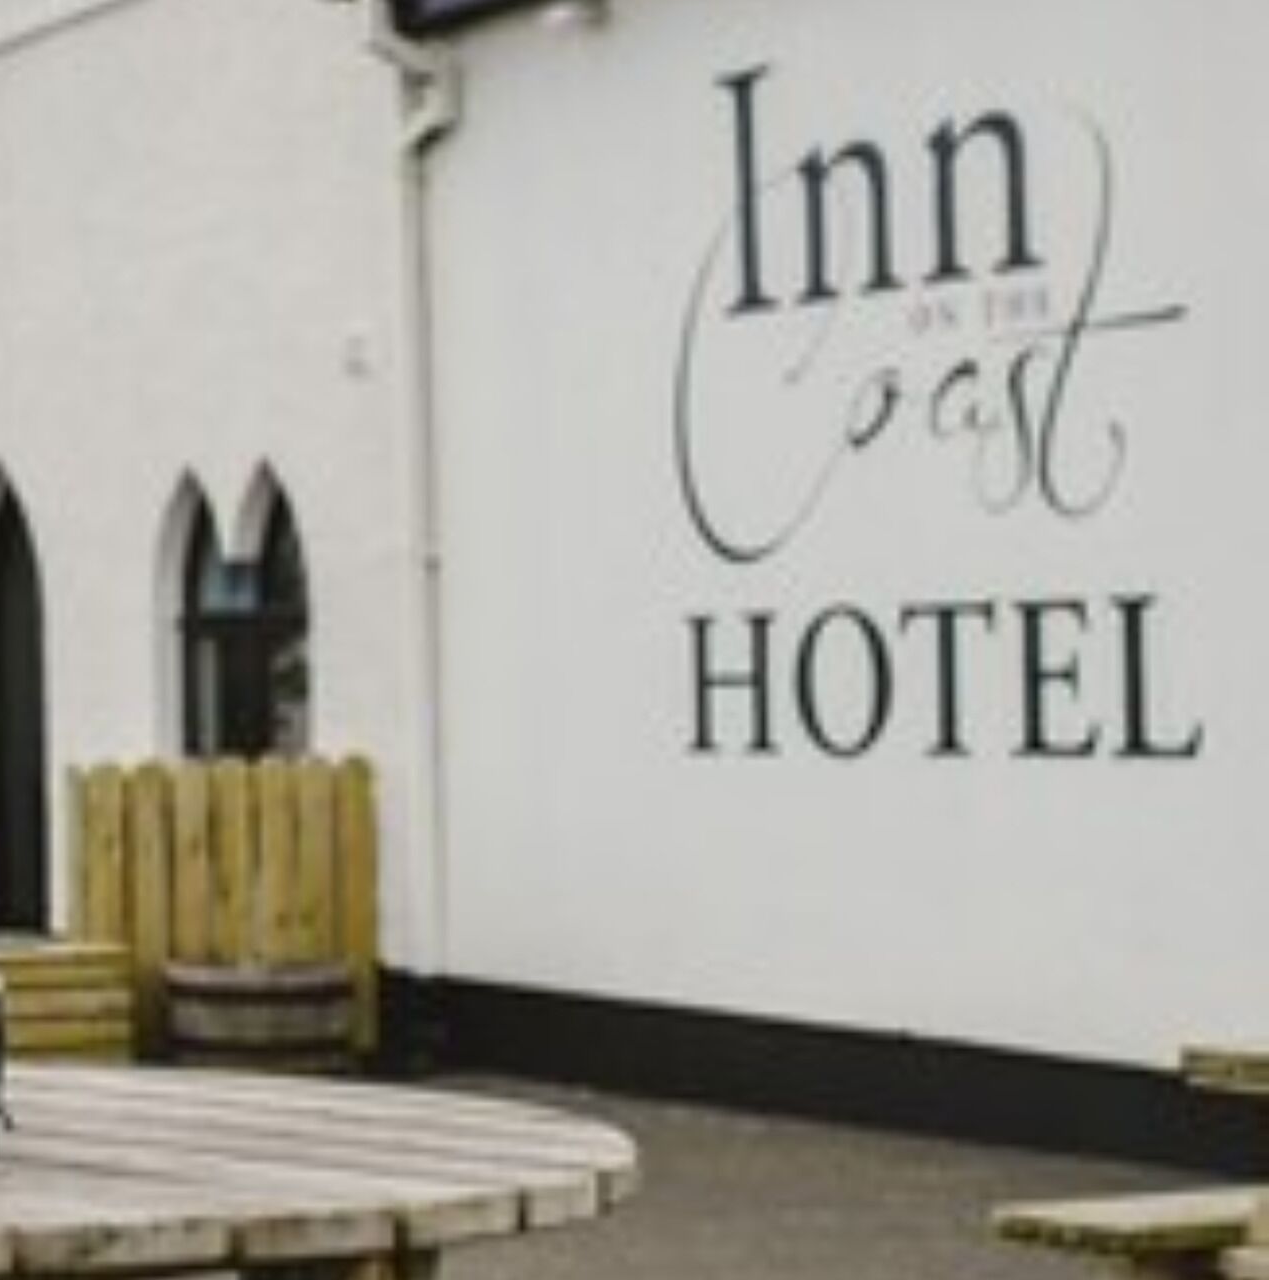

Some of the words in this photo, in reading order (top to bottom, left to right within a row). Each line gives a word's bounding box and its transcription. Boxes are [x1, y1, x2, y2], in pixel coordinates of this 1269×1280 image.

[714, 63, 1044, 317] Inn
[672, 98, 1190, 564] Coast
[685, 593, 1205, 759] HOTEL
